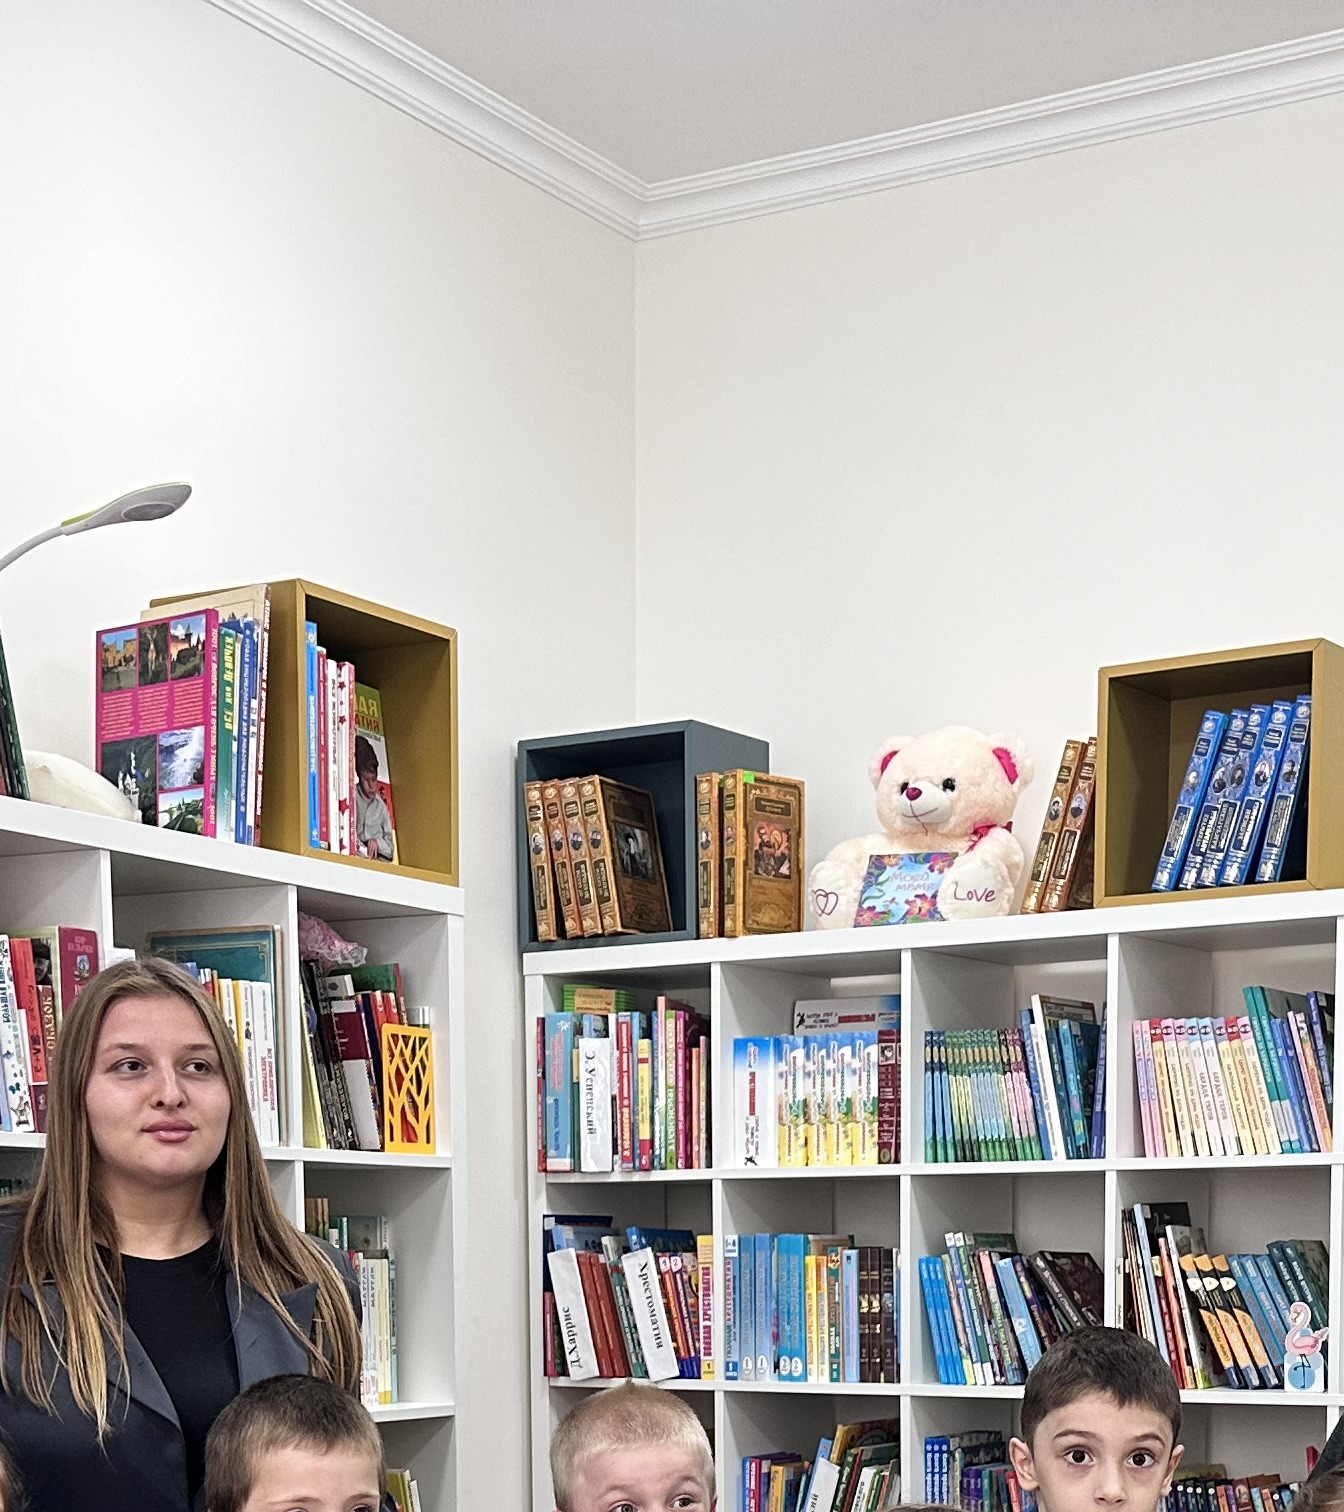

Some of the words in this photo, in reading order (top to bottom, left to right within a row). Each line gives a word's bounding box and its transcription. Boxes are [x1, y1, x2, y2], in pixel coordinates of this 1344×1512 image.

[222, 635, 235, 683] ДЕВОЧЕК
[951, 881, 996, 905] Love
[41, 995, 56, 1049] СКАЗОК
[635, 1260, 665, 1351] Хрестоматия
[700, 1264, 712, 1322] ХРЕСТОМАТИЯ
[560, 1303, 583, 1370] Д.Харрис
